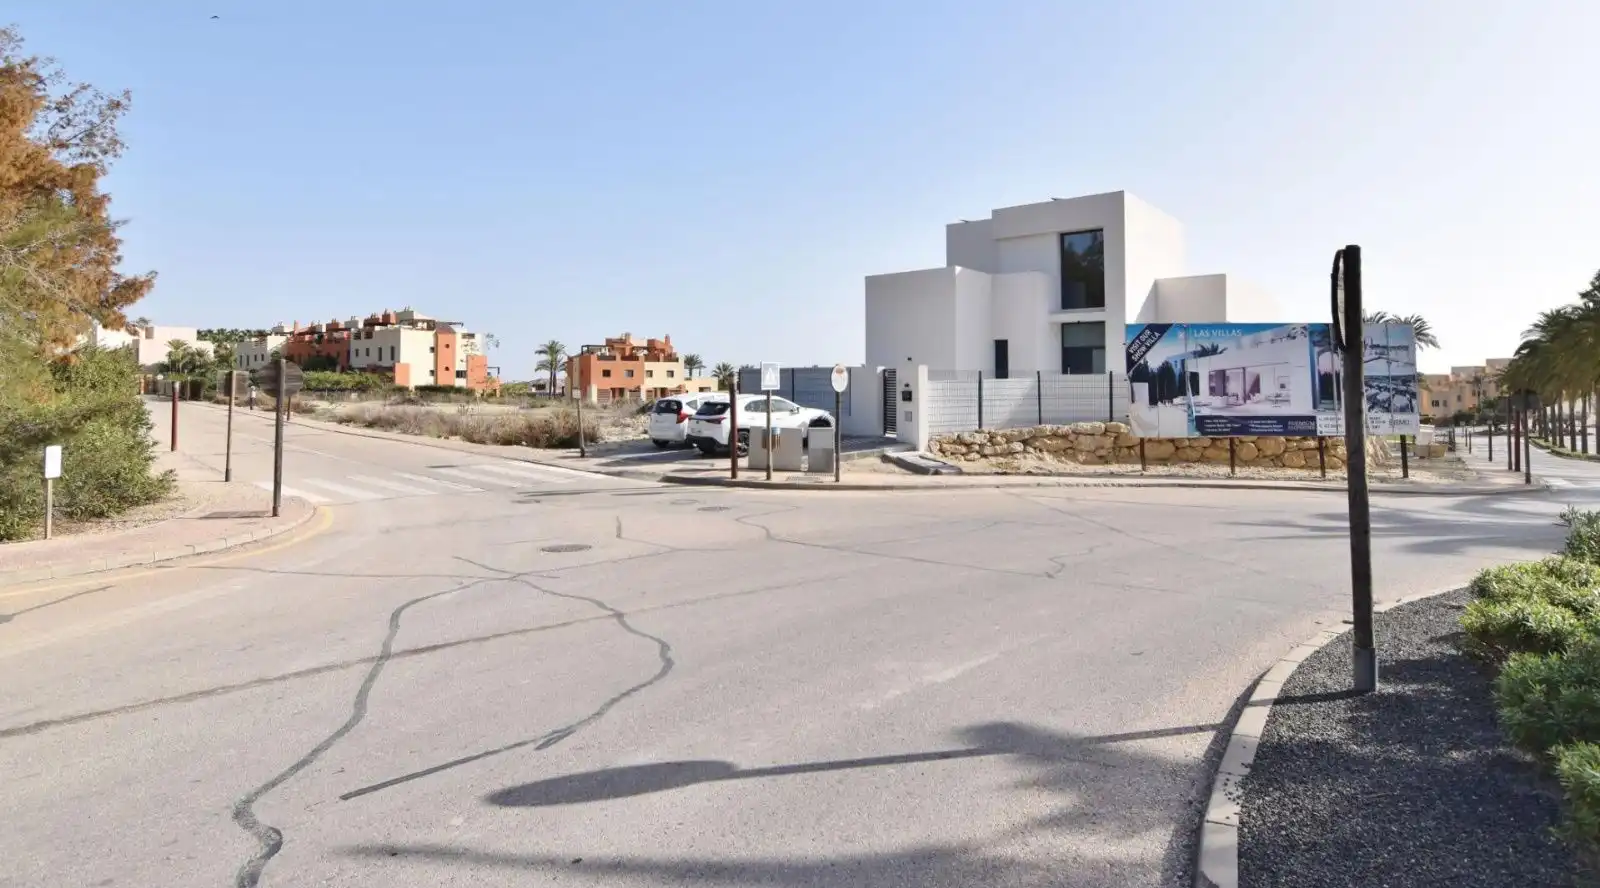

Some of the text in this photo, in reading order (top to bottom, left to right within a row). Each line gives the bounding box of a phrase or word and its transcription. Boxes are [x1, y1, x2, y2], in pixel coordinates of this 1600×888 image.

[1128, 329, 1152, 354] VISIT OUR
[1212, 329, 1242, 337] VILLAS
[1131, 331, 1160, 361] SHOW VILLA
